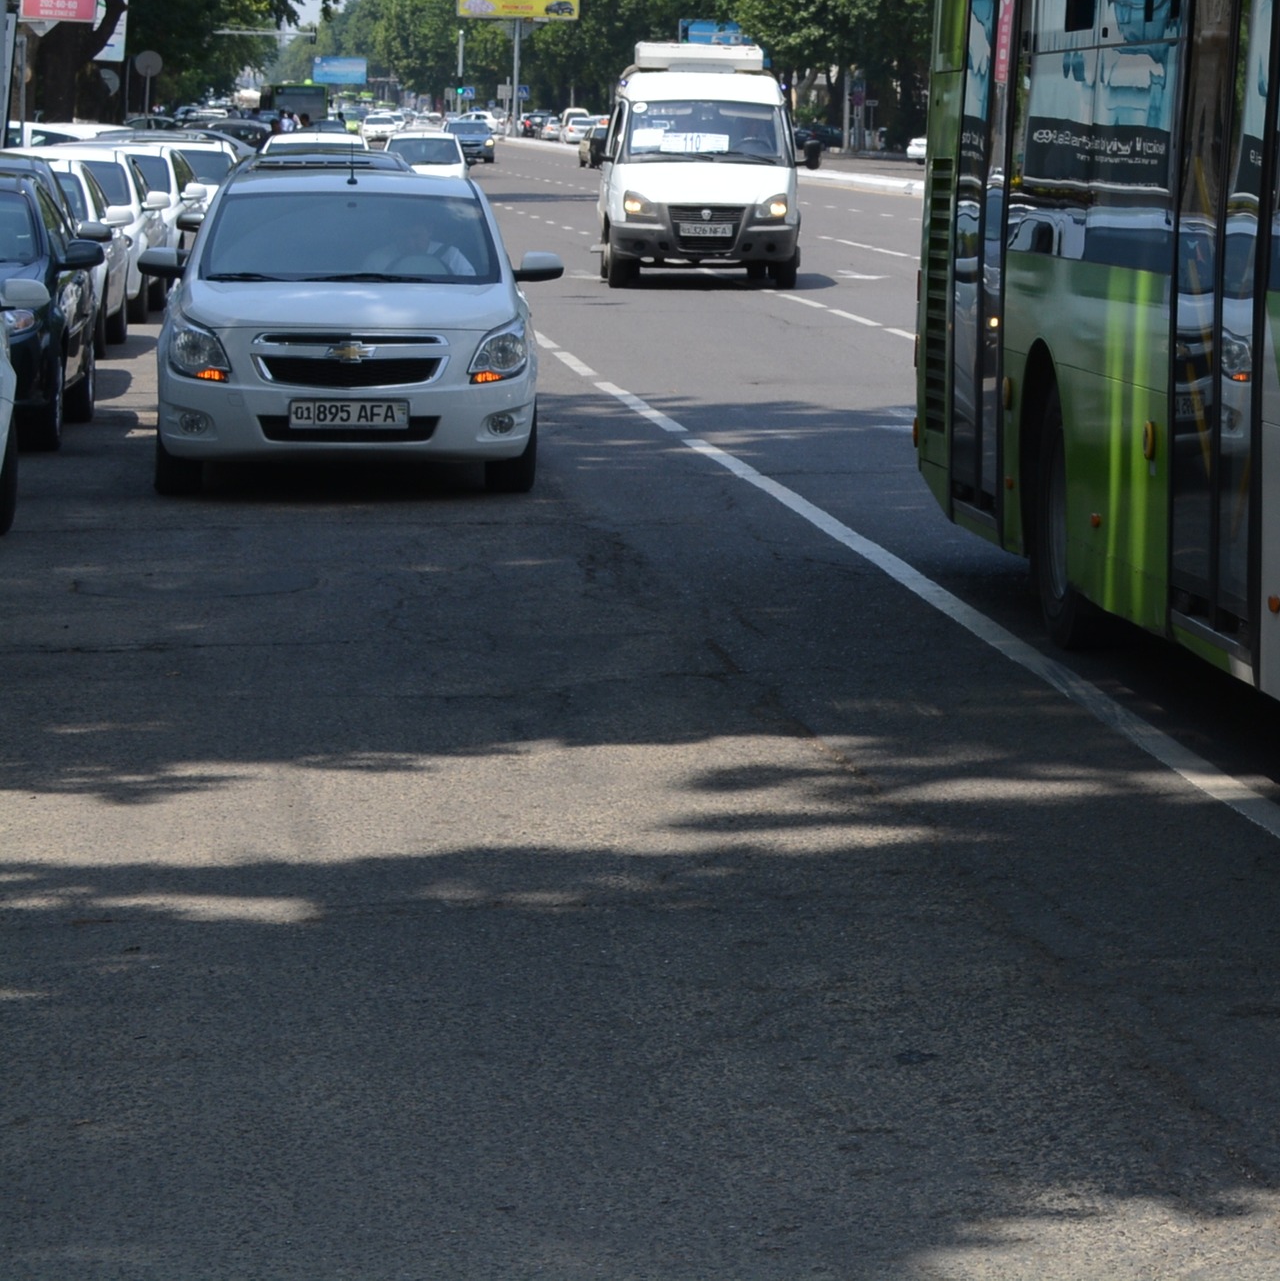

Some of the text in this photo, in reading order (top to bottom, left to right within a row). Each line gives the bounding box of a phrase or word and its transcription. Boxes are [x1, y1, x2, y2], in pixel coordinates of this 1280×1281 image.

[295, 406, 312, 420] 01
[316, 404, 351, 422] 895
[357, 404, 395, 422] AFA
